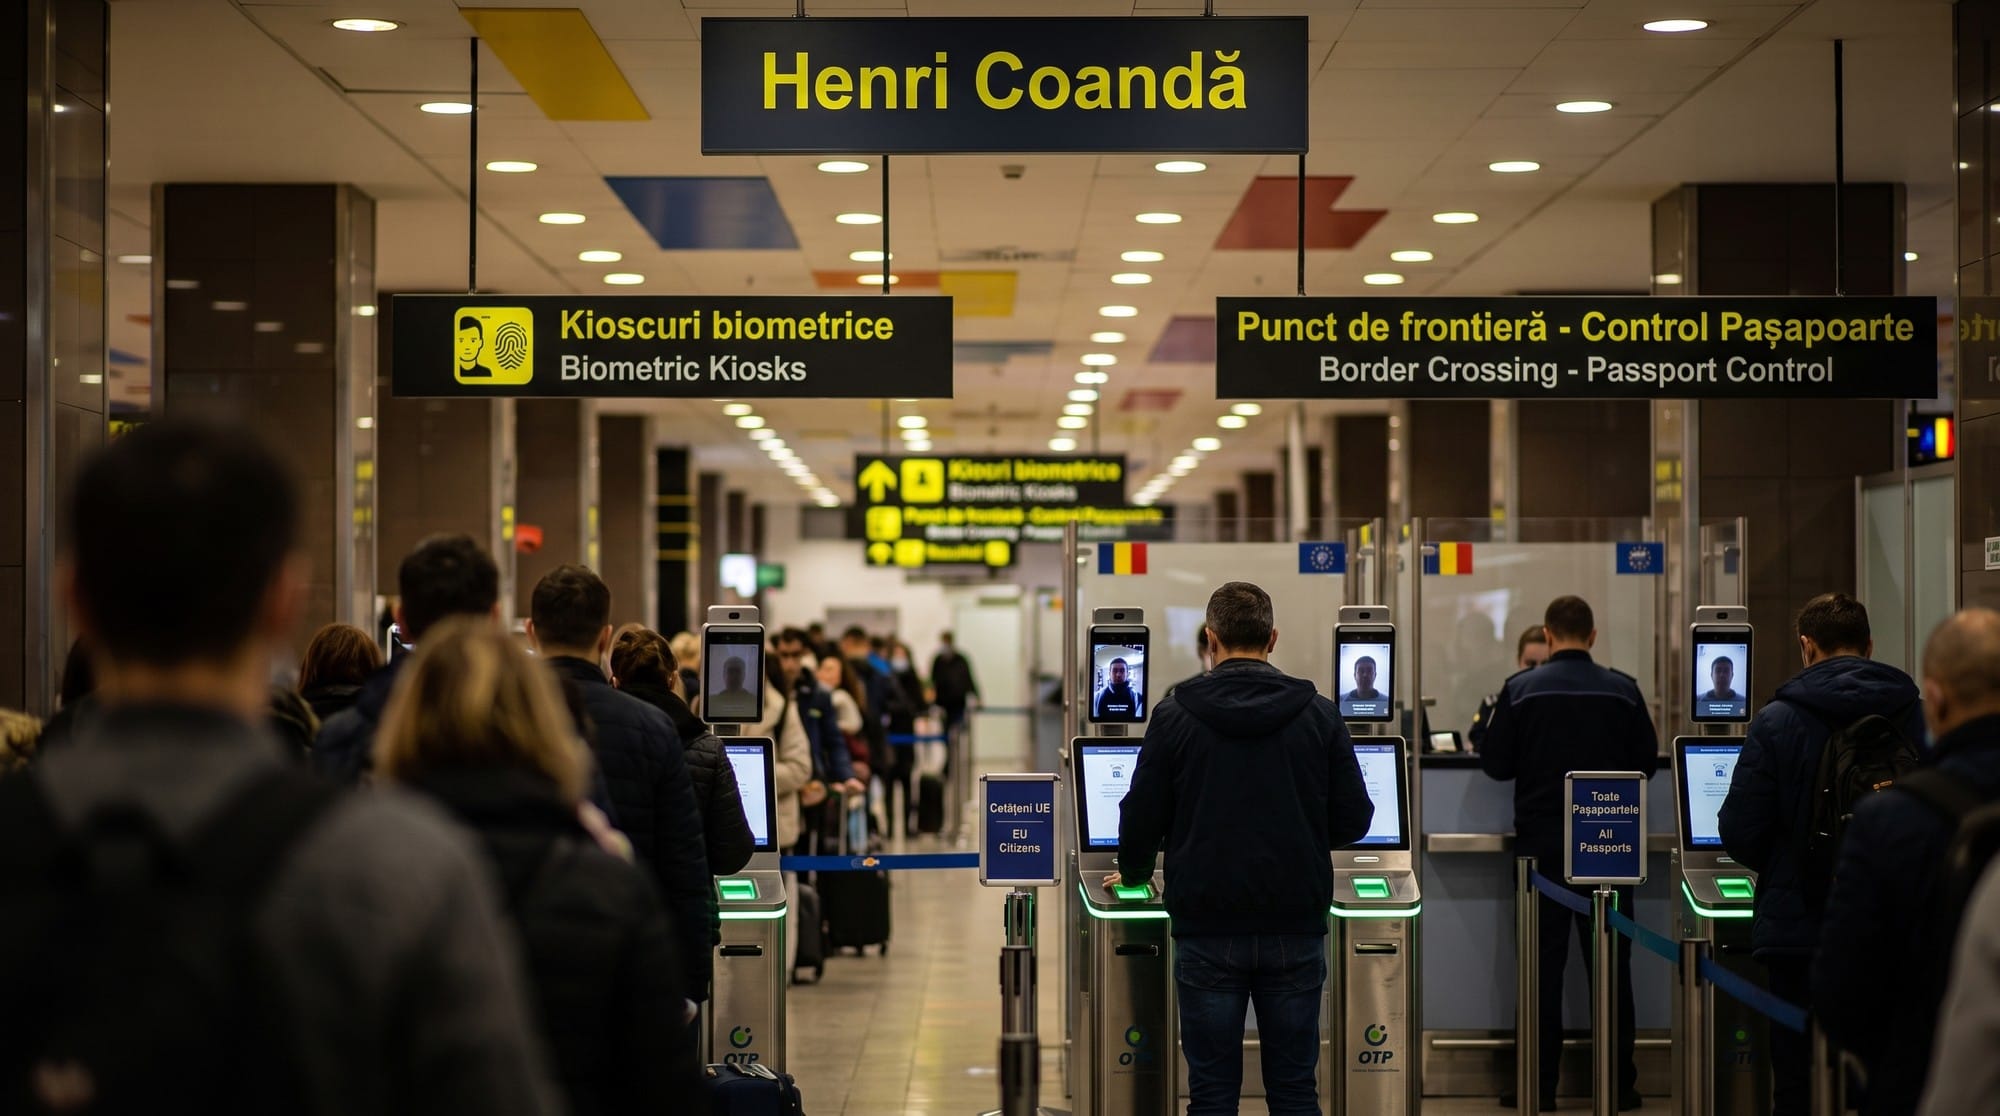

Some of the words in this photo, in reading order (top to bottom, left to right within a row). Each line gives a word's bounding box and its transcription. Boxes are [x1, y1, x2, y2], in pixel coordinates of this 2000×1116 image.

[763, 52, 948, 111] Henri
[975, 50, 1247, 111] Coandă
[561, 310, 701, 341] Kioscuri
[712, 310, 894, 341] biometrice
[1238, 312, 1338, 342] Punct
[1348, 312, 1390, 342] de
[1399, 311, 1548, 342] frontieră
[1559, 326, 1571, 334] -
[1581, 311, 1708, 342] Control
[1721, 311, 1914, 350] Pașapoarte
[561, 355, 700, 382] Biometric
[709, 355, 807, 382] Kiosks
[1320, 356, 1420, 382] Border
[1427, 356, 1558, 389] Crossing
[1587, 357, 1717, 388] Passport
[1726, 356, 1833, 382] Control
[1591, 791, 1620, 802] Toate
[1035, 803, 1051, 814] UE
[1012, 828, 1028, 840] EU
[1598, 828, 1613, 839] All
[999, 842, 1041, 853] Citizens
[1579, 842, 1632, 855] Passports
[723, 1052, 760, 1065] OTP
[1358, 1050, 1394, 1065] OTP
